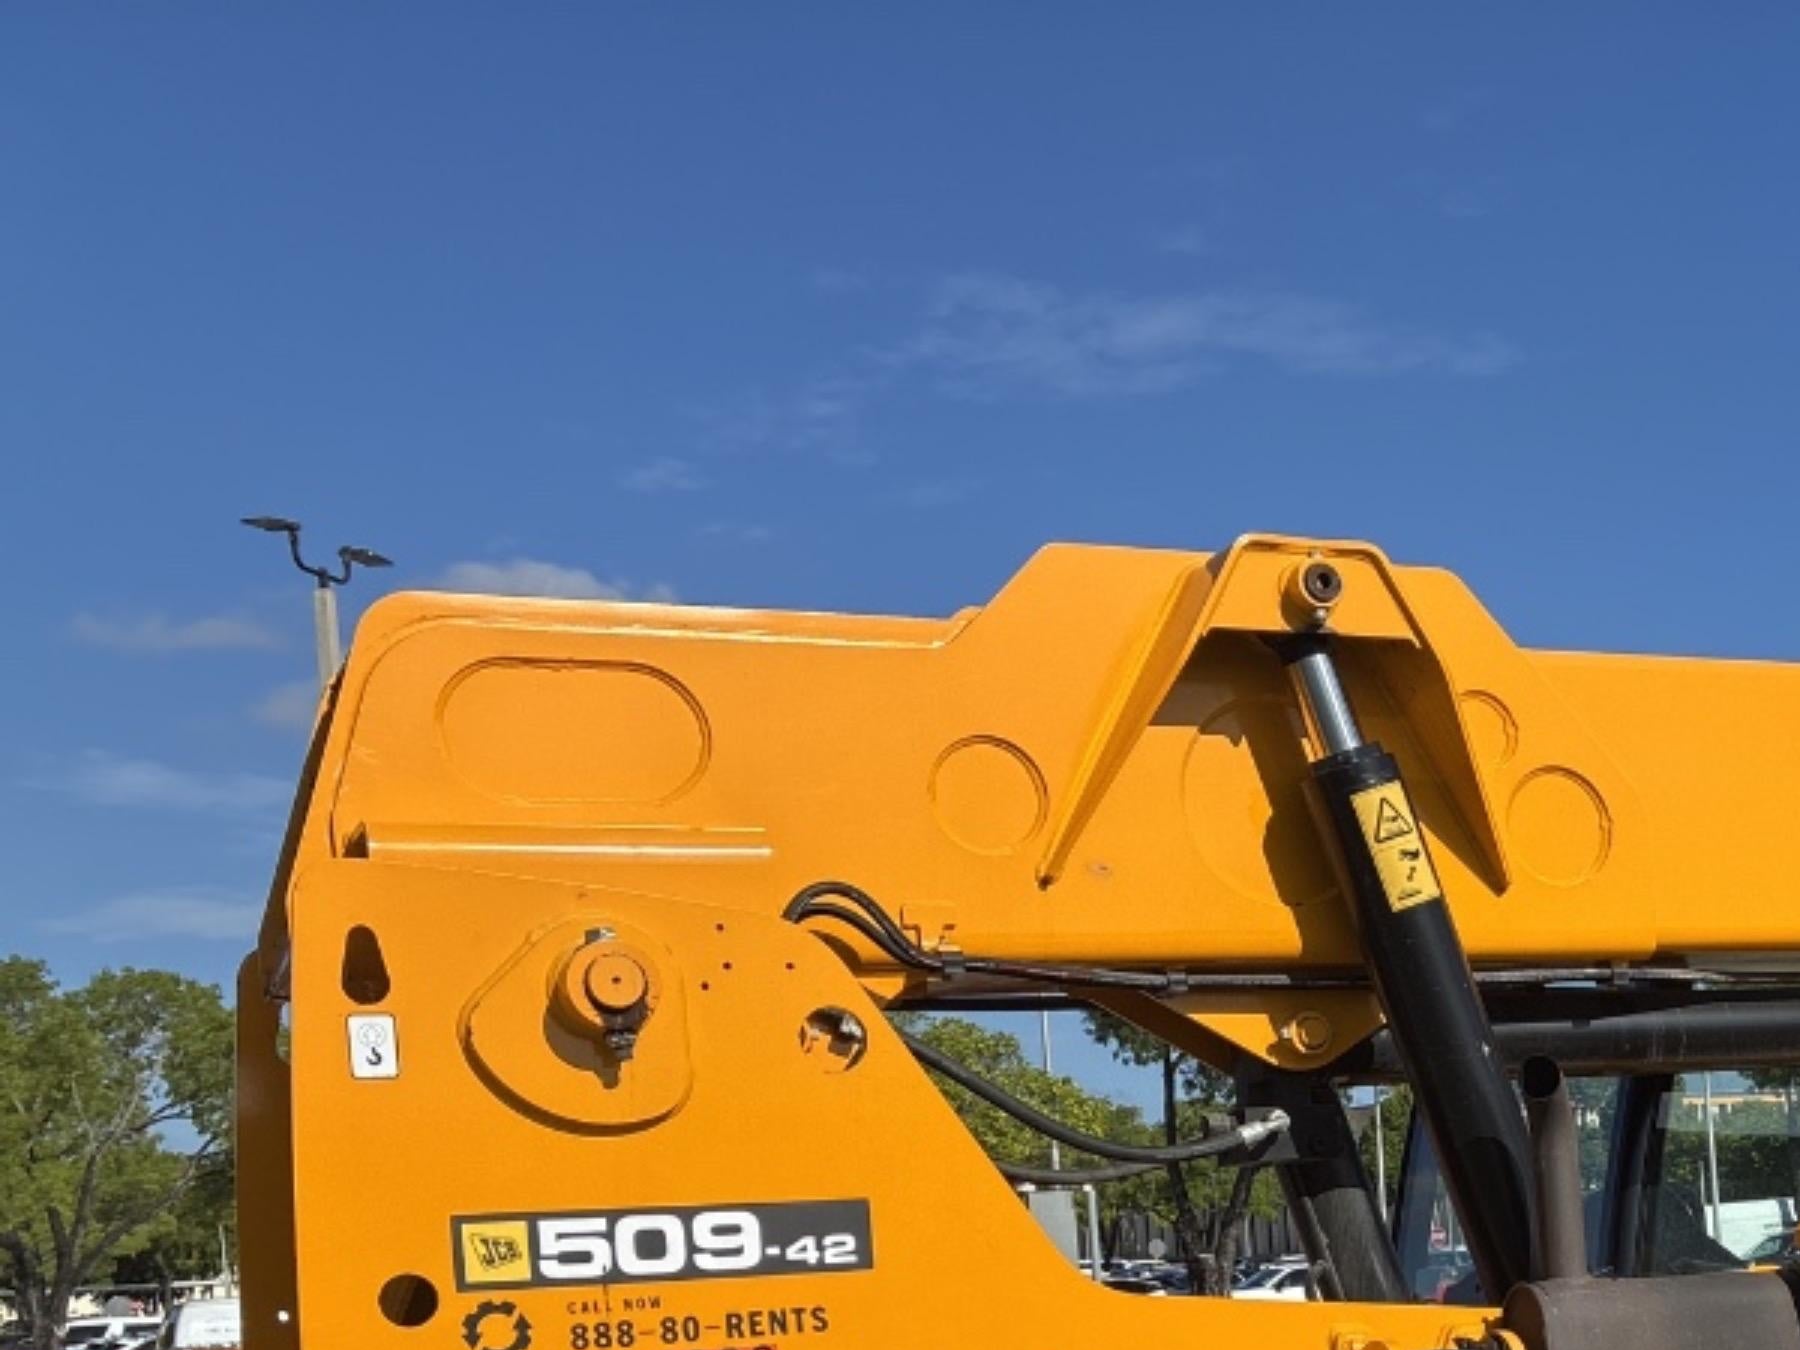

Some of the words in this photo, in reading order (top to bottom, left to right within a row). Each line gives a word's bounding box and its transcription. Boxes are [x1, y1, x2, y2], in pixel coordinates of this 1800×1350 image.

[537, 1210, 859, 1280] 509-42
[567, 1300, 613, 1315] CALL
[623, 1296, 662, 1311] NOW
[570, 1306, 830, 1350] 888-80-RENTS
